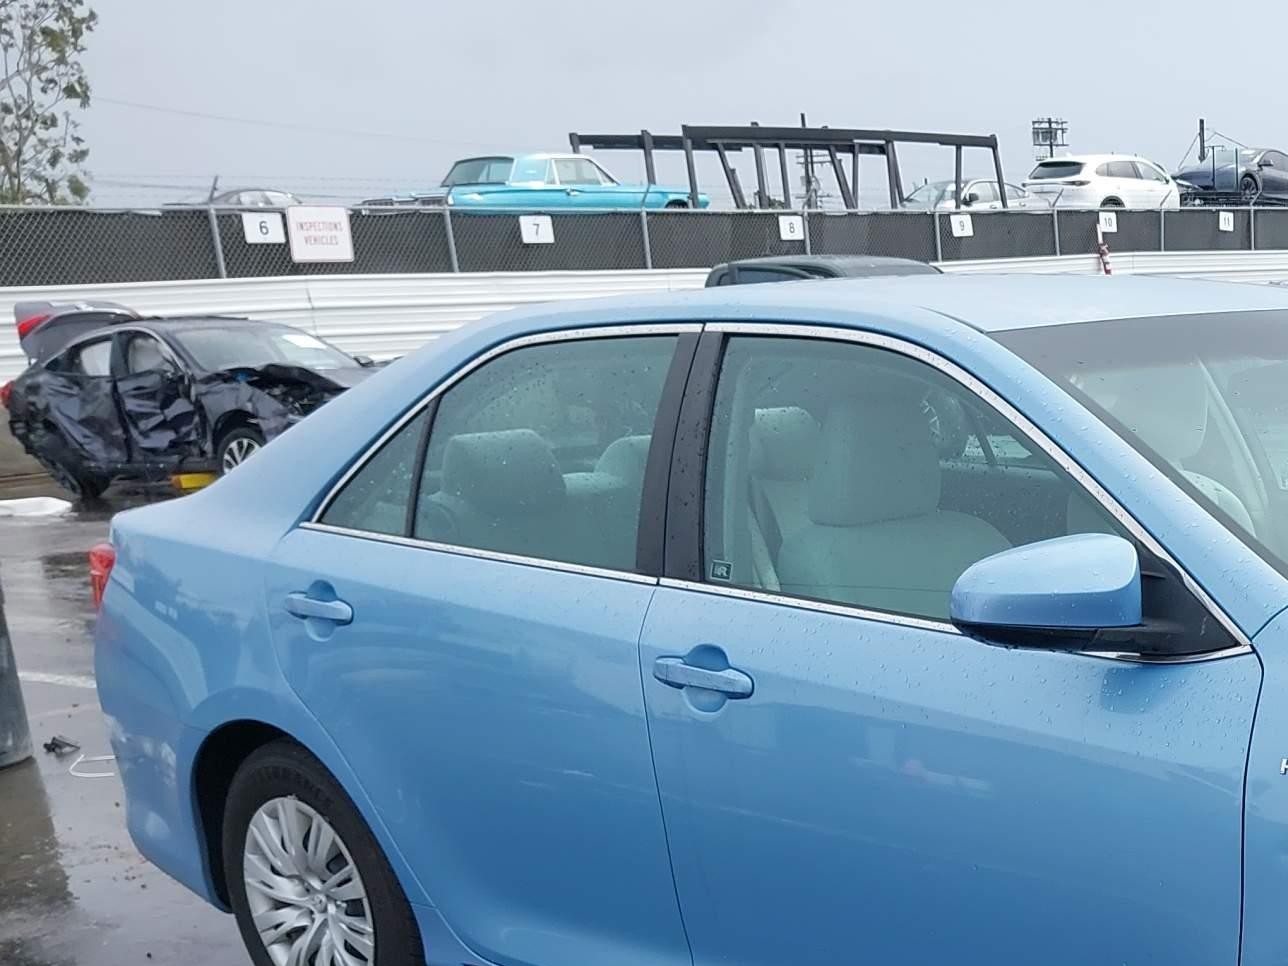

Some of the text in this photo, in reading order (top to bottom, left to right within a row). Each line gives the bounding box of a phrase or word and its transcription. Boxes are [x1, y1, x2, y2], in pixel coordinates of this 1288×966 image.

[959, 219, 965, 231] 9
[1104, 217, 1113, 227] 10
[1223, 216, 1231, 227] 11
[258, 220, 269, 236] 6
[532, 223, 540, 236] 7
[789, 222, 796, 234] 8
[303, 234, 338, 246] VEHICLES
